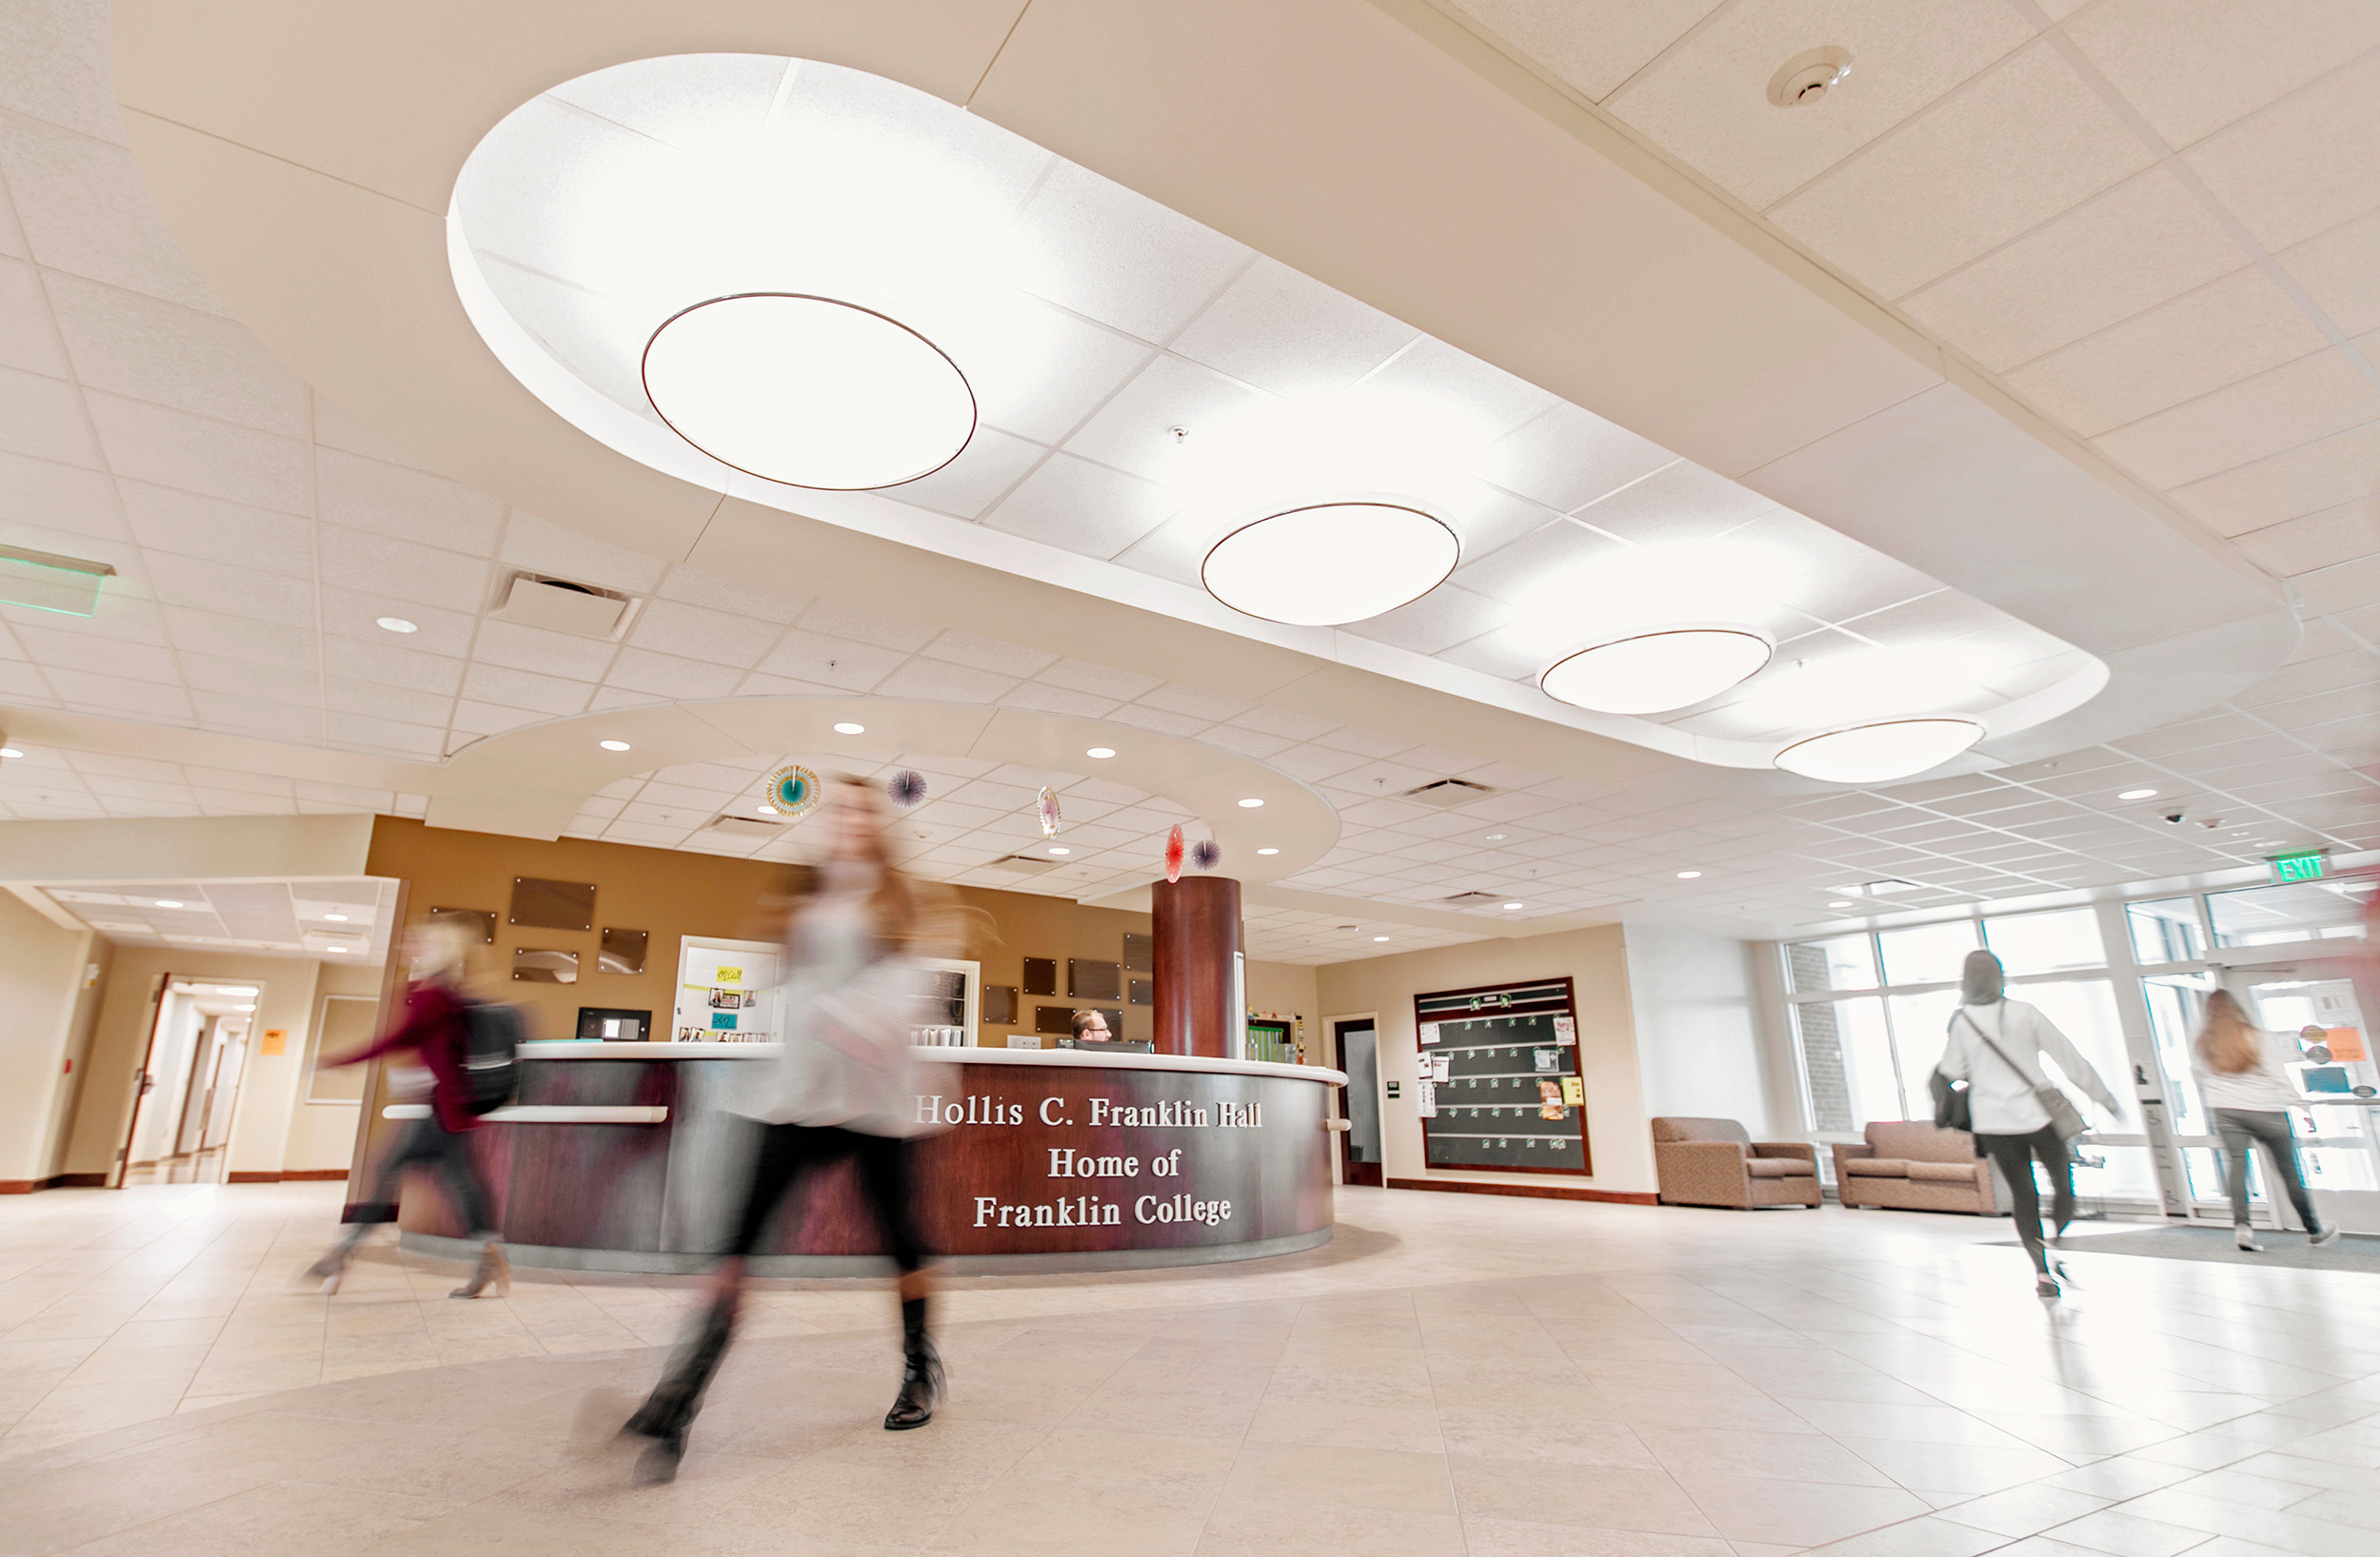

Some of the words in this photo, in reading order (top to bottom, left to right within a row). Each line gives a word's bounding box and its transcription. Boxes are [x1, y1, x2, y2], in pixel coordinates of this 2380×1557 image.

[2276, 855, 2324, 882] EXIT
[913, 1094, 1023, 1125] Hollis
[1039, 1096, 1074, 1126] C.
[1088, 1097, 1209, 1128] Franklin
[1216, 1101, 1262, 1128] Hall
[1047, 1148, 1140, 1178] Home
[1152, 1148, 1182, 1177] of
[972, 1195, 1122, 1228] Franklin
[1134, 1193, 1232, 1227] College
